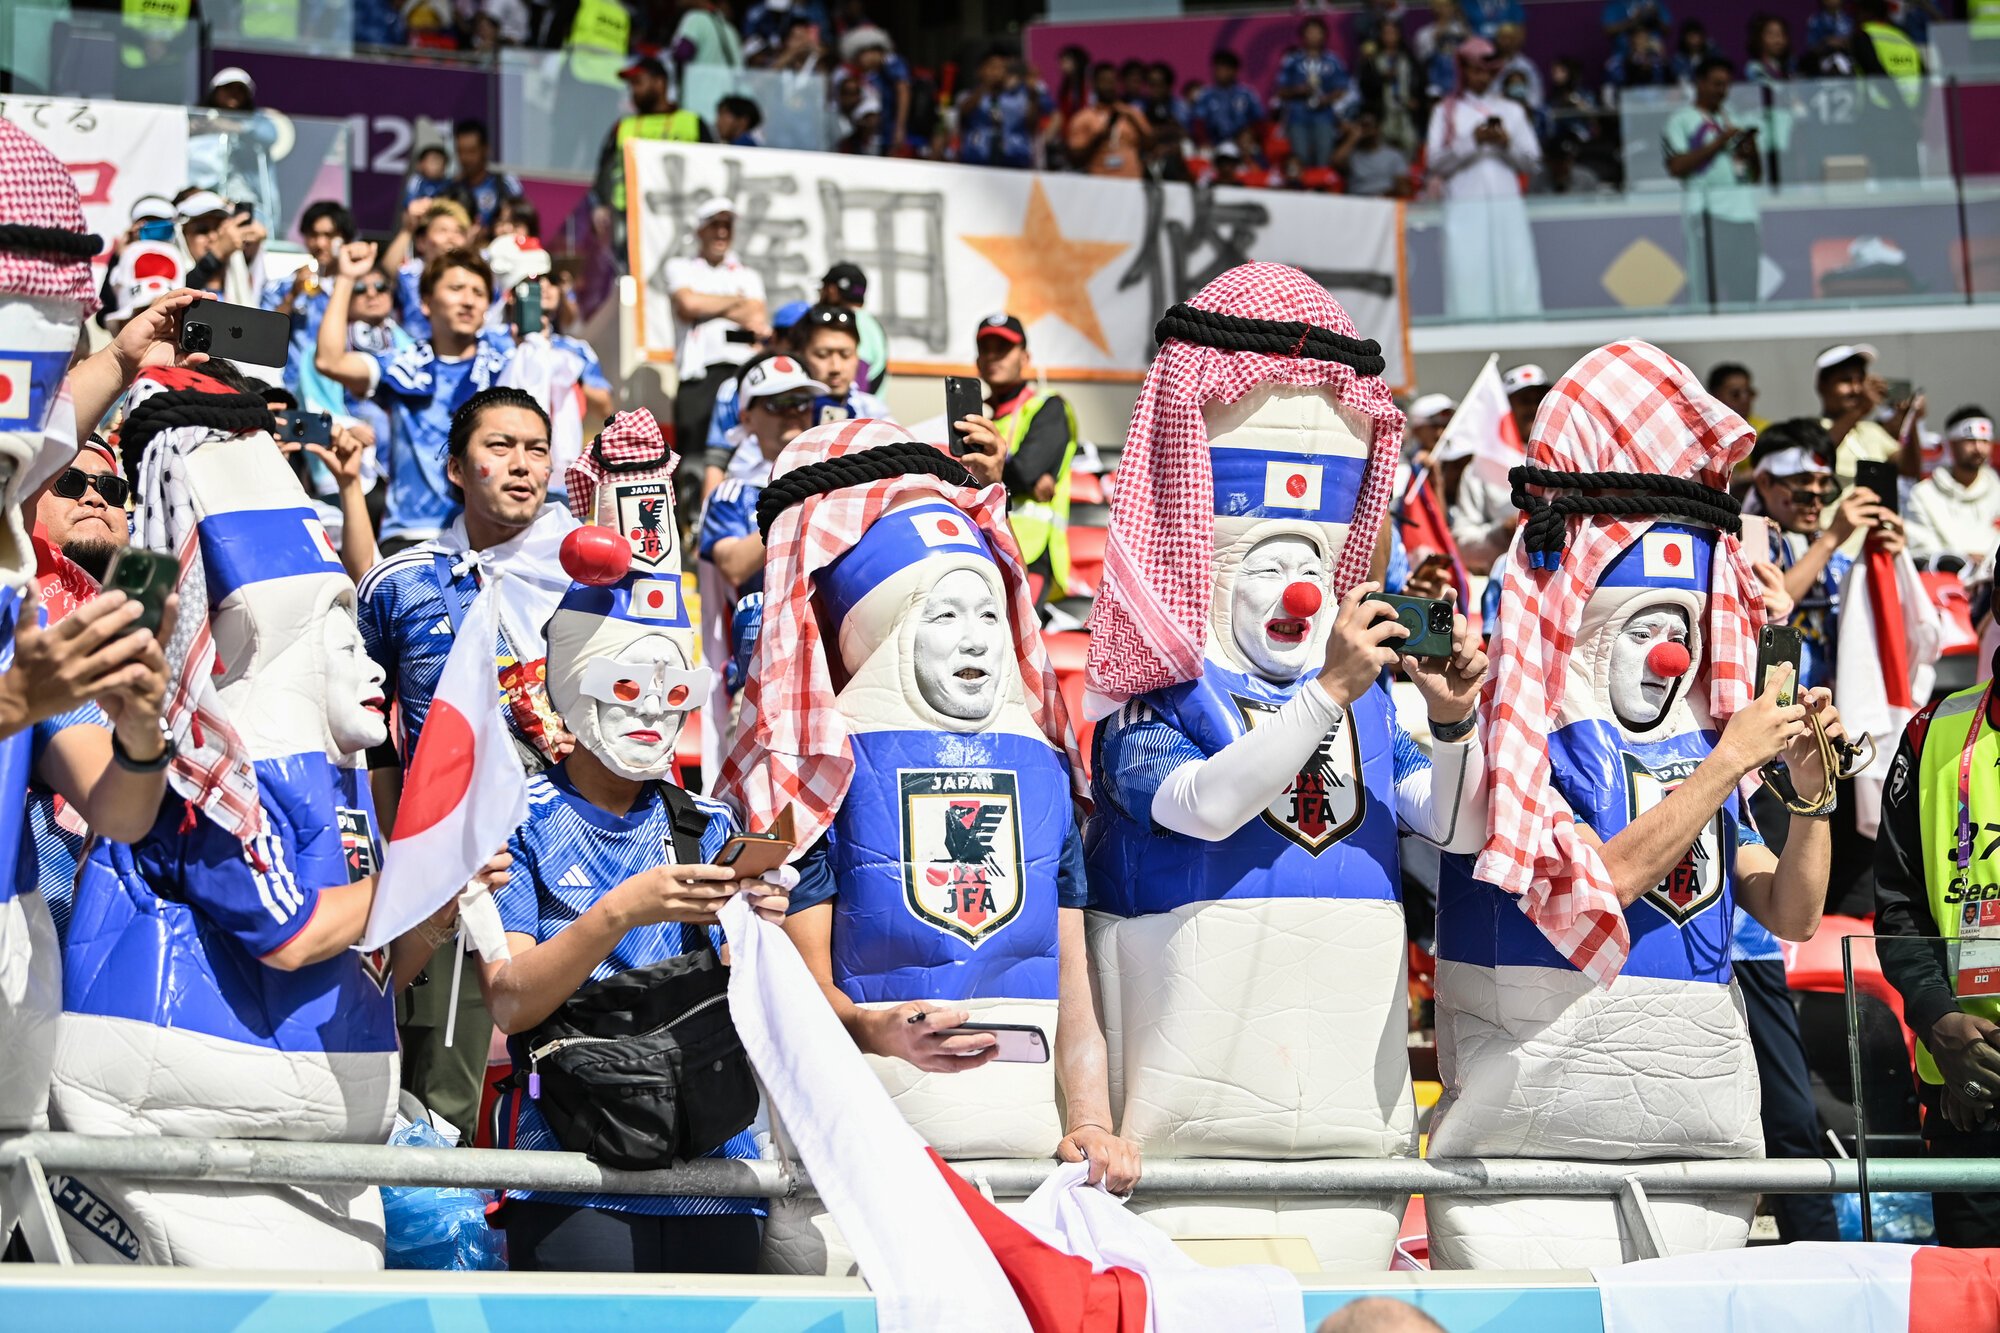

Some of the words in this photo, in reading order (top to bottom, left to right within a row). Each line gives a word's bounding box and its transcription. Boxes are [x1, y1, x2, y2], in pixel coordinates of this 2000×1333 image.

[630, 485, 661, 495] JAPAN
[638, 539, 664, 553] JFA
[931, 776, 994, 790] JAPAN
[1651, 764, 1695, 781] APAN
[1286, 798, 1338, 825] JFA
[1658, 868, 1703, 895] JFA
[1944, 877, 2000, 904] Sec
[942, 887, 998, 914] JFA
